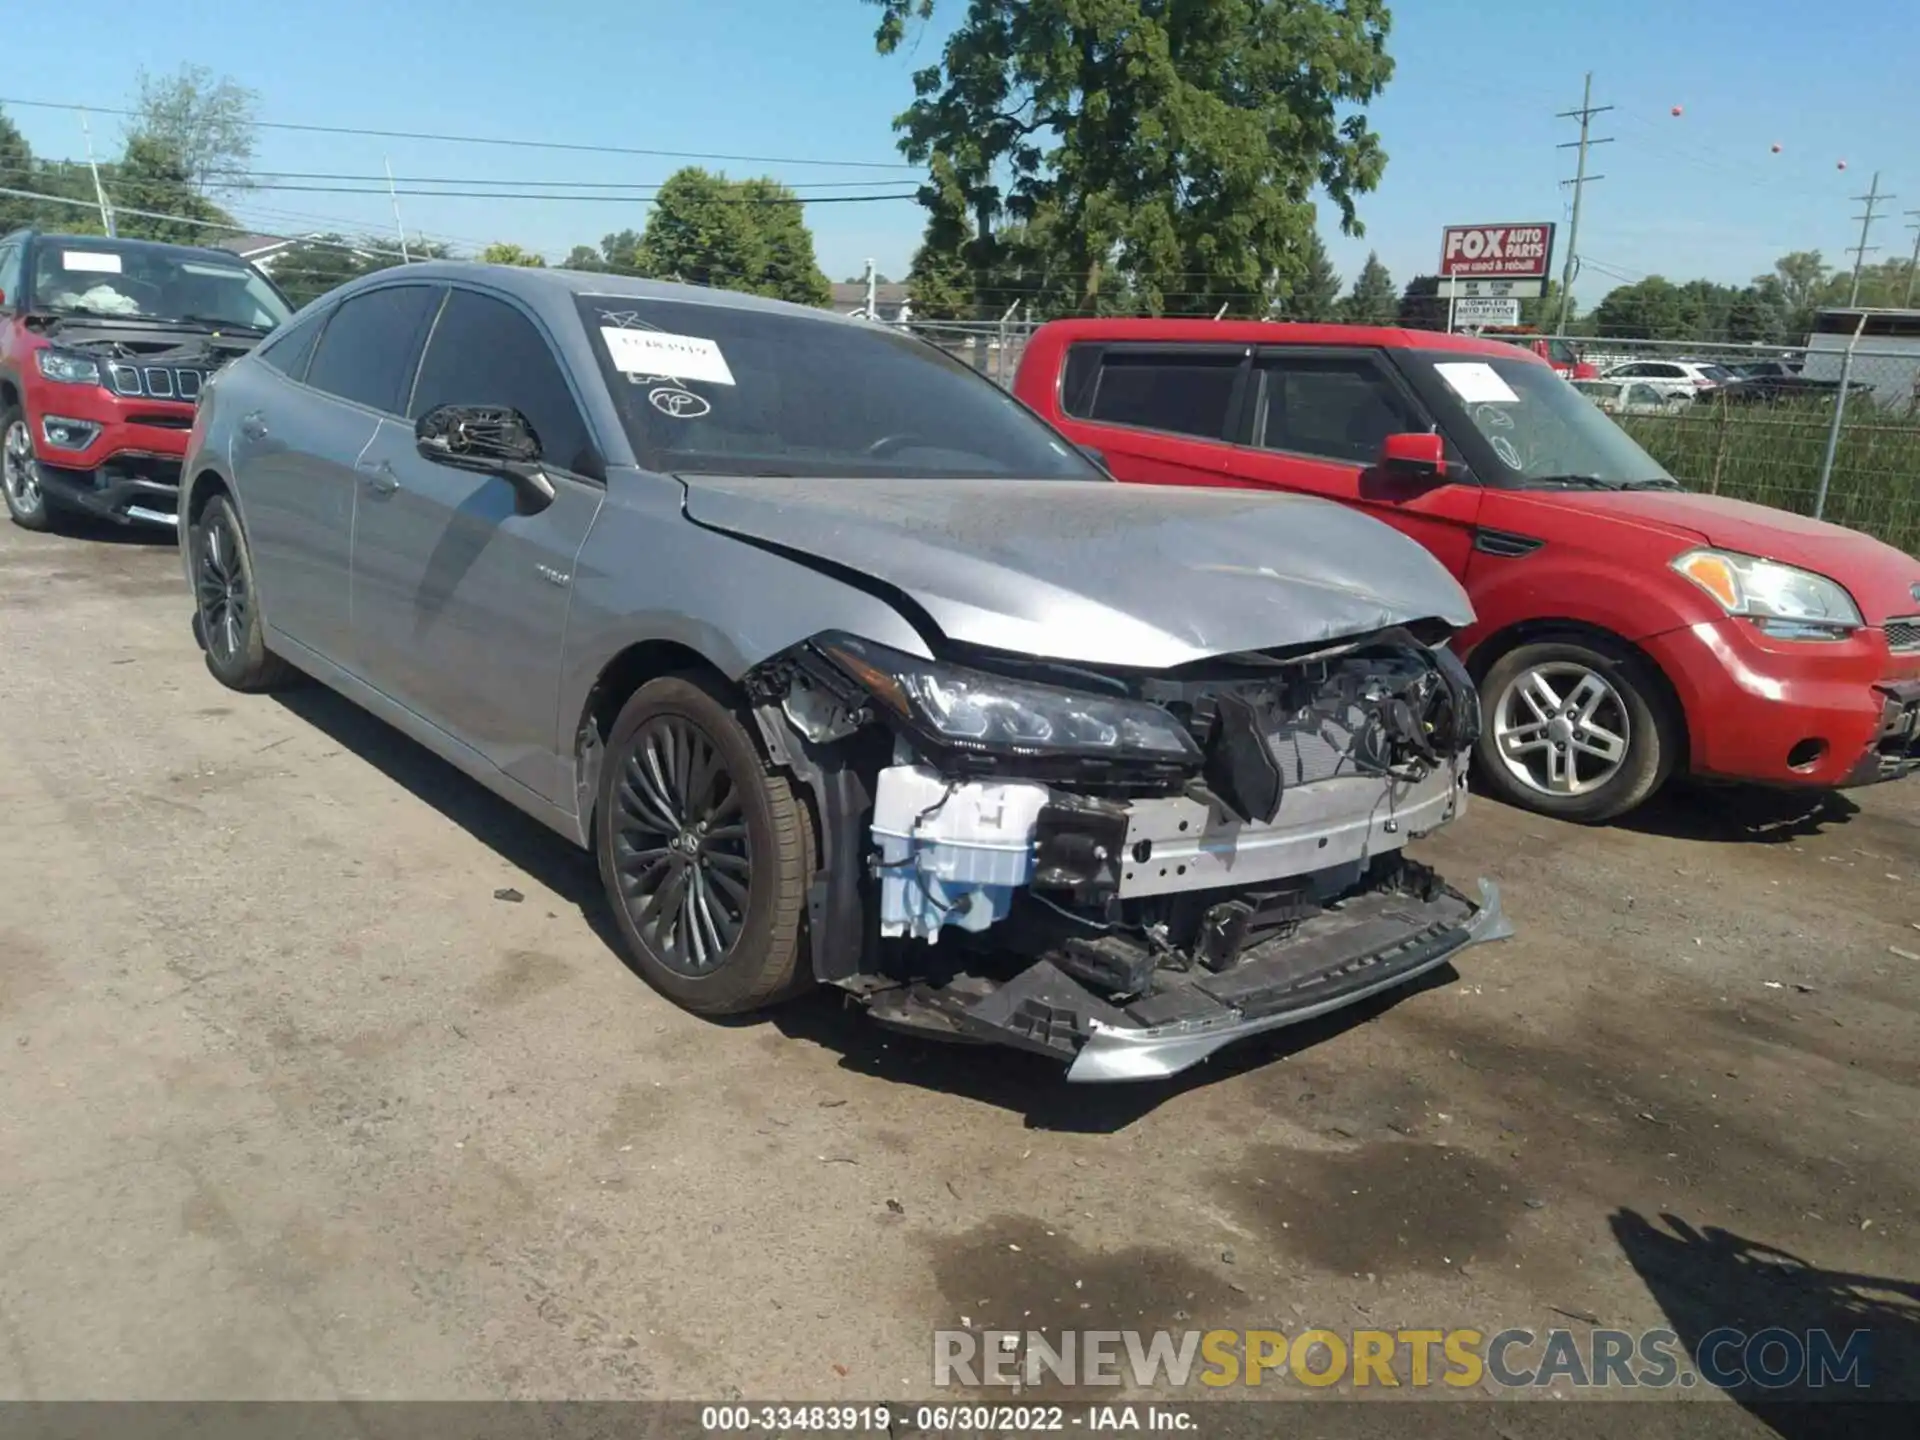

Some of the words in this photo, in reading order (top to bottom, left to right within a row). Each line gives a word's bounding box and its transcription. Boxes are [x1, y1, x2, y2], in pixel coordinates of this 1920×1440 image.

[1507, 229, 1541, 243] AUTO
[1446, 230, 1505, 259] FOX
[1505, 243, 1543, 257] PARTS
